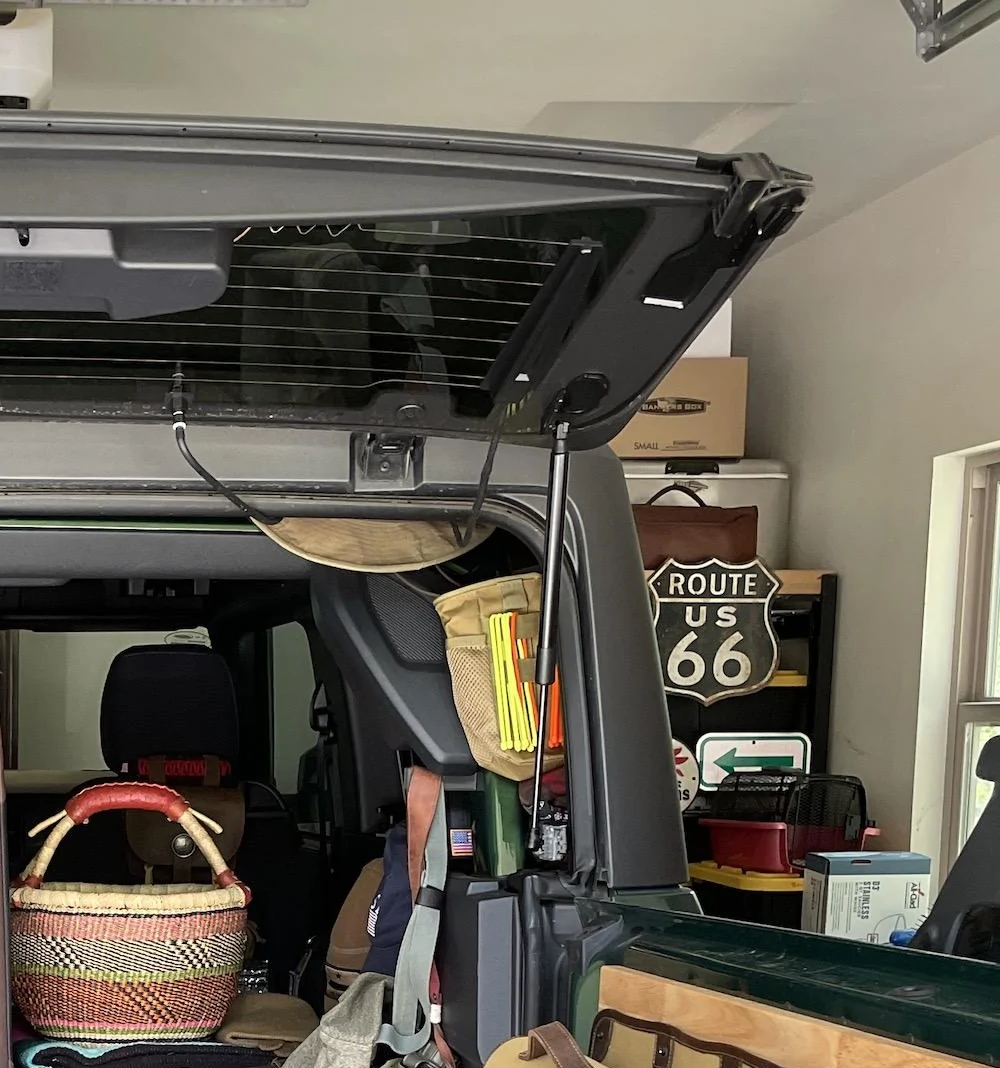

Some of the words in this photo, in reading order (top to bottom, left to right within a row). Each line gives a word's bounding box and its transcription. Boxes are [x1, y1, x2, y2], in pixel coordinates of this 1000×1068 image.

[684, 403, 703, 411] BOX
[634, 441, 659, 450] SMALL
[668, 572, 758, 596] ROUTE
[685, 605, 738, 628] US
[667, 630, 752, 687] 66
[861, 881, 871, 920] STAINLESS
